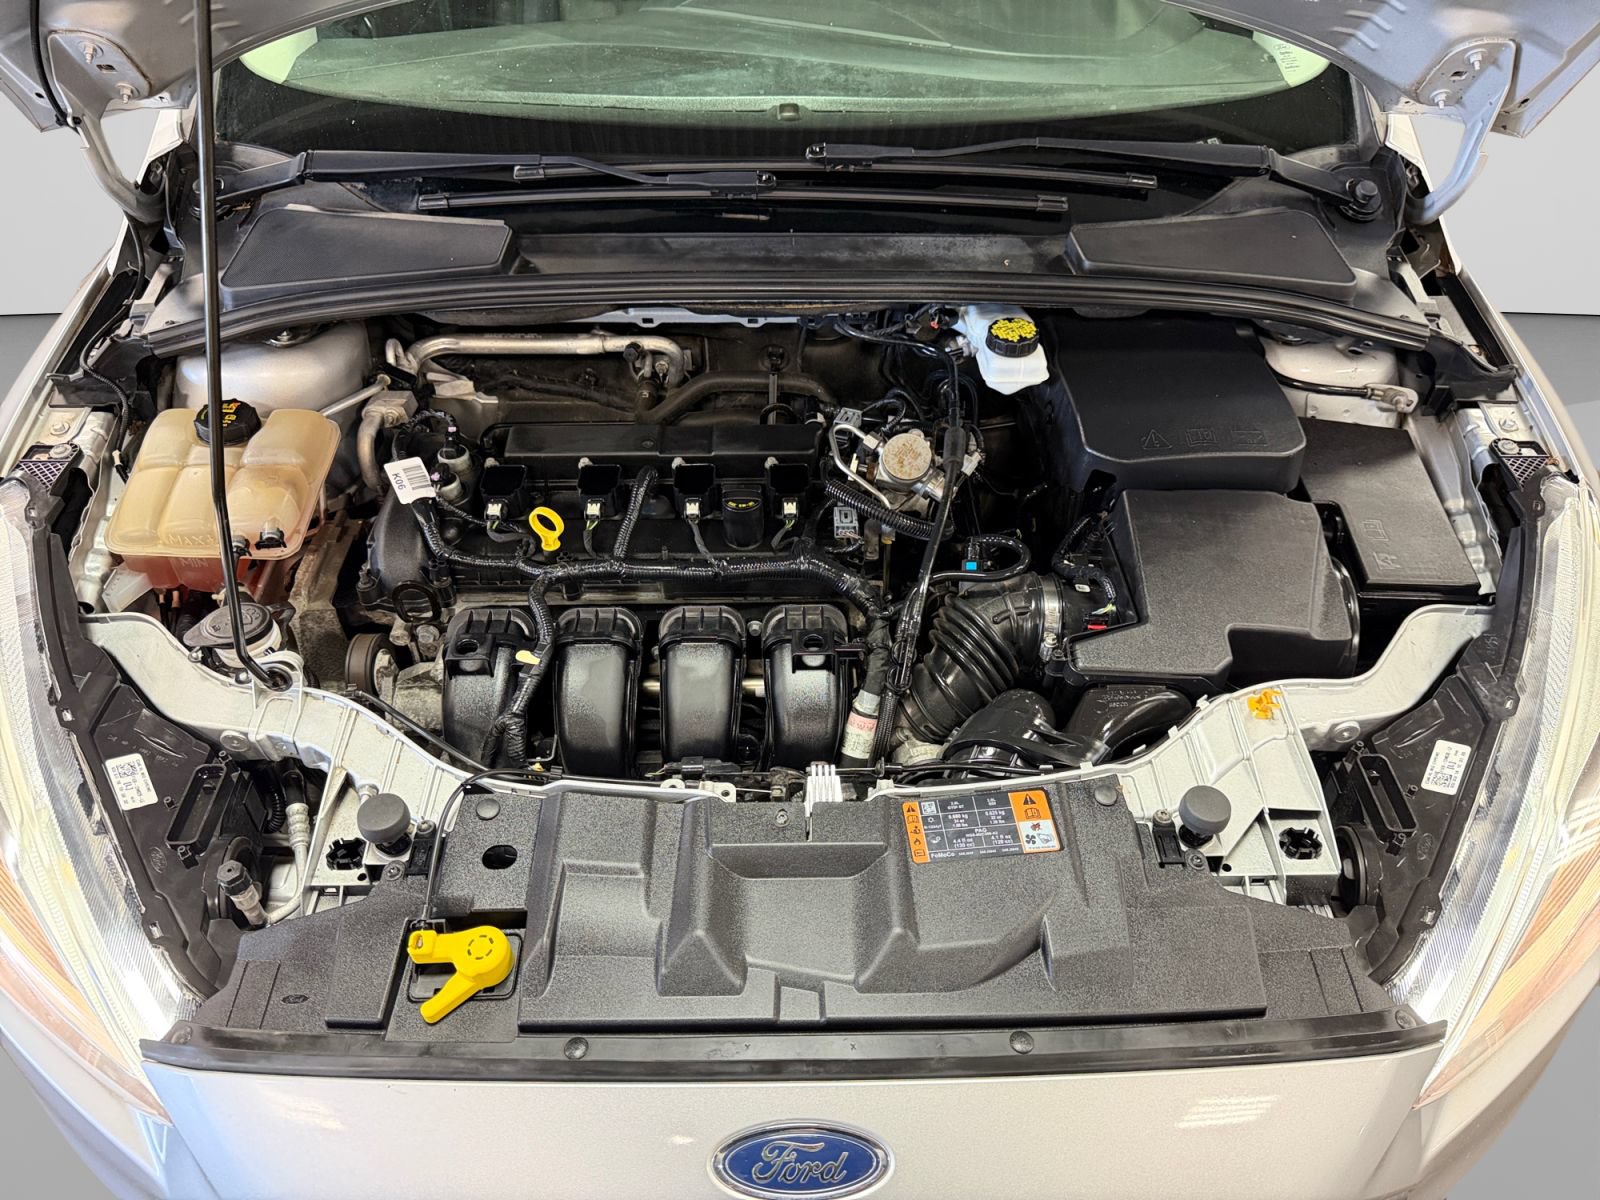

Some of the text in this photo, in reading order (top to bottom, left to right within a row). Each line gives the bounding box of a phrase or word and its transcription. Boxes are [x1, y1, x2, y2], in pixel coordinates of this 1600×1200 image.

[392, 473, 406, 490] K06
[168, 535, 205, 545] MAX
[752, 1141, 848, 1184] Ford
